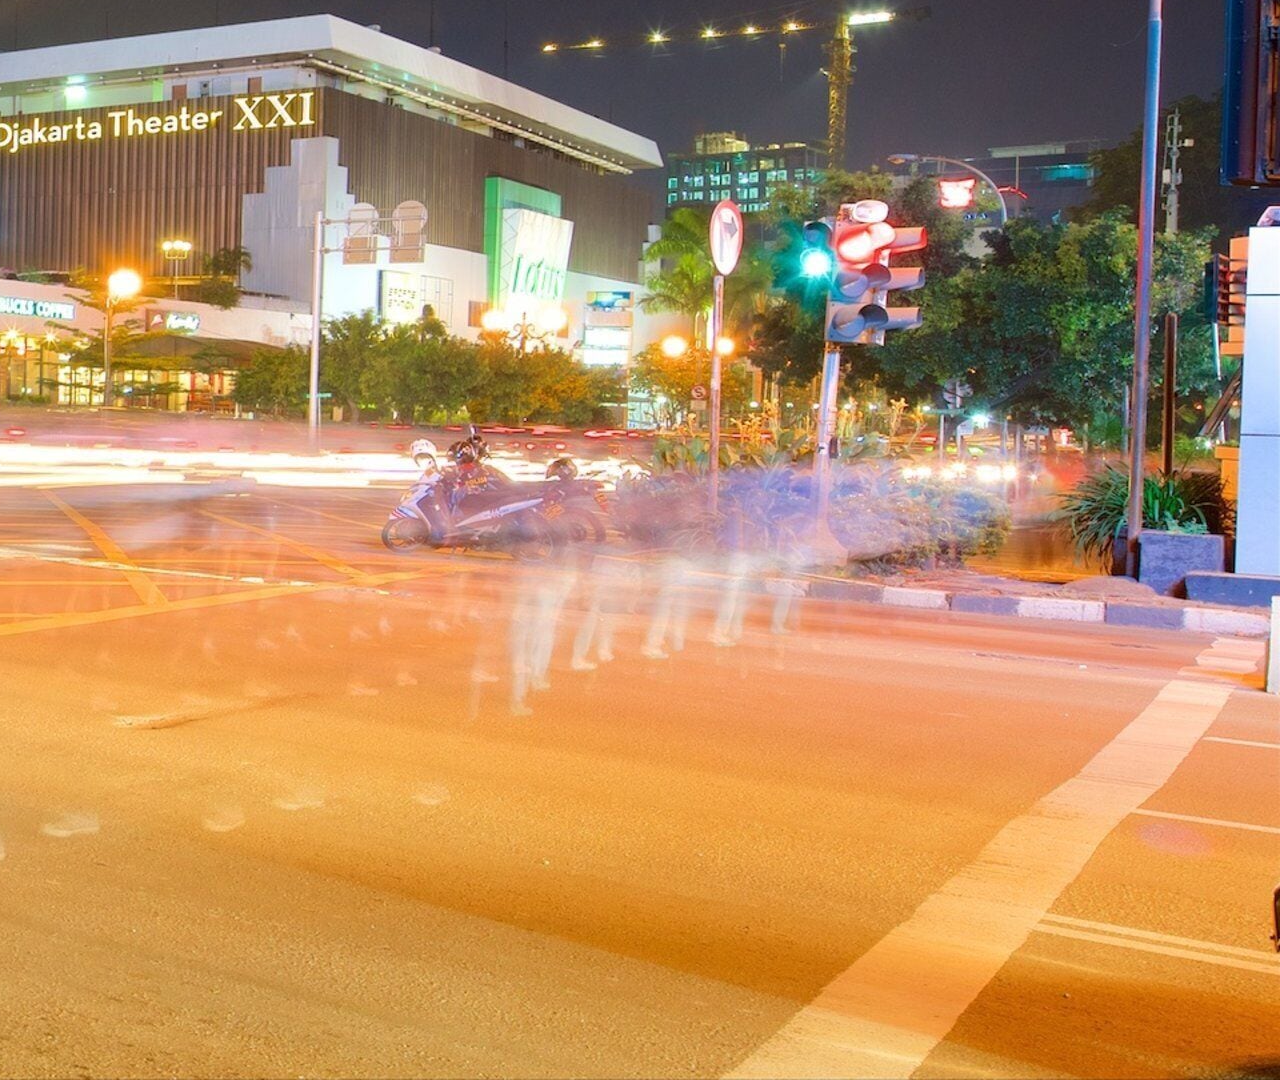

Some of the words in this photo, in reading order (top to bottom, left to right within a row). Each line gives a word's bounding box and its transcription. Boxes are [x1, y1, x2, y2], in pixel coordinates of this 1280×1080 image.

[107, 106, 223, 137] Theater
[233, 92, 316, 131] XXI
[36, 300, 75, 320] COFFEE
